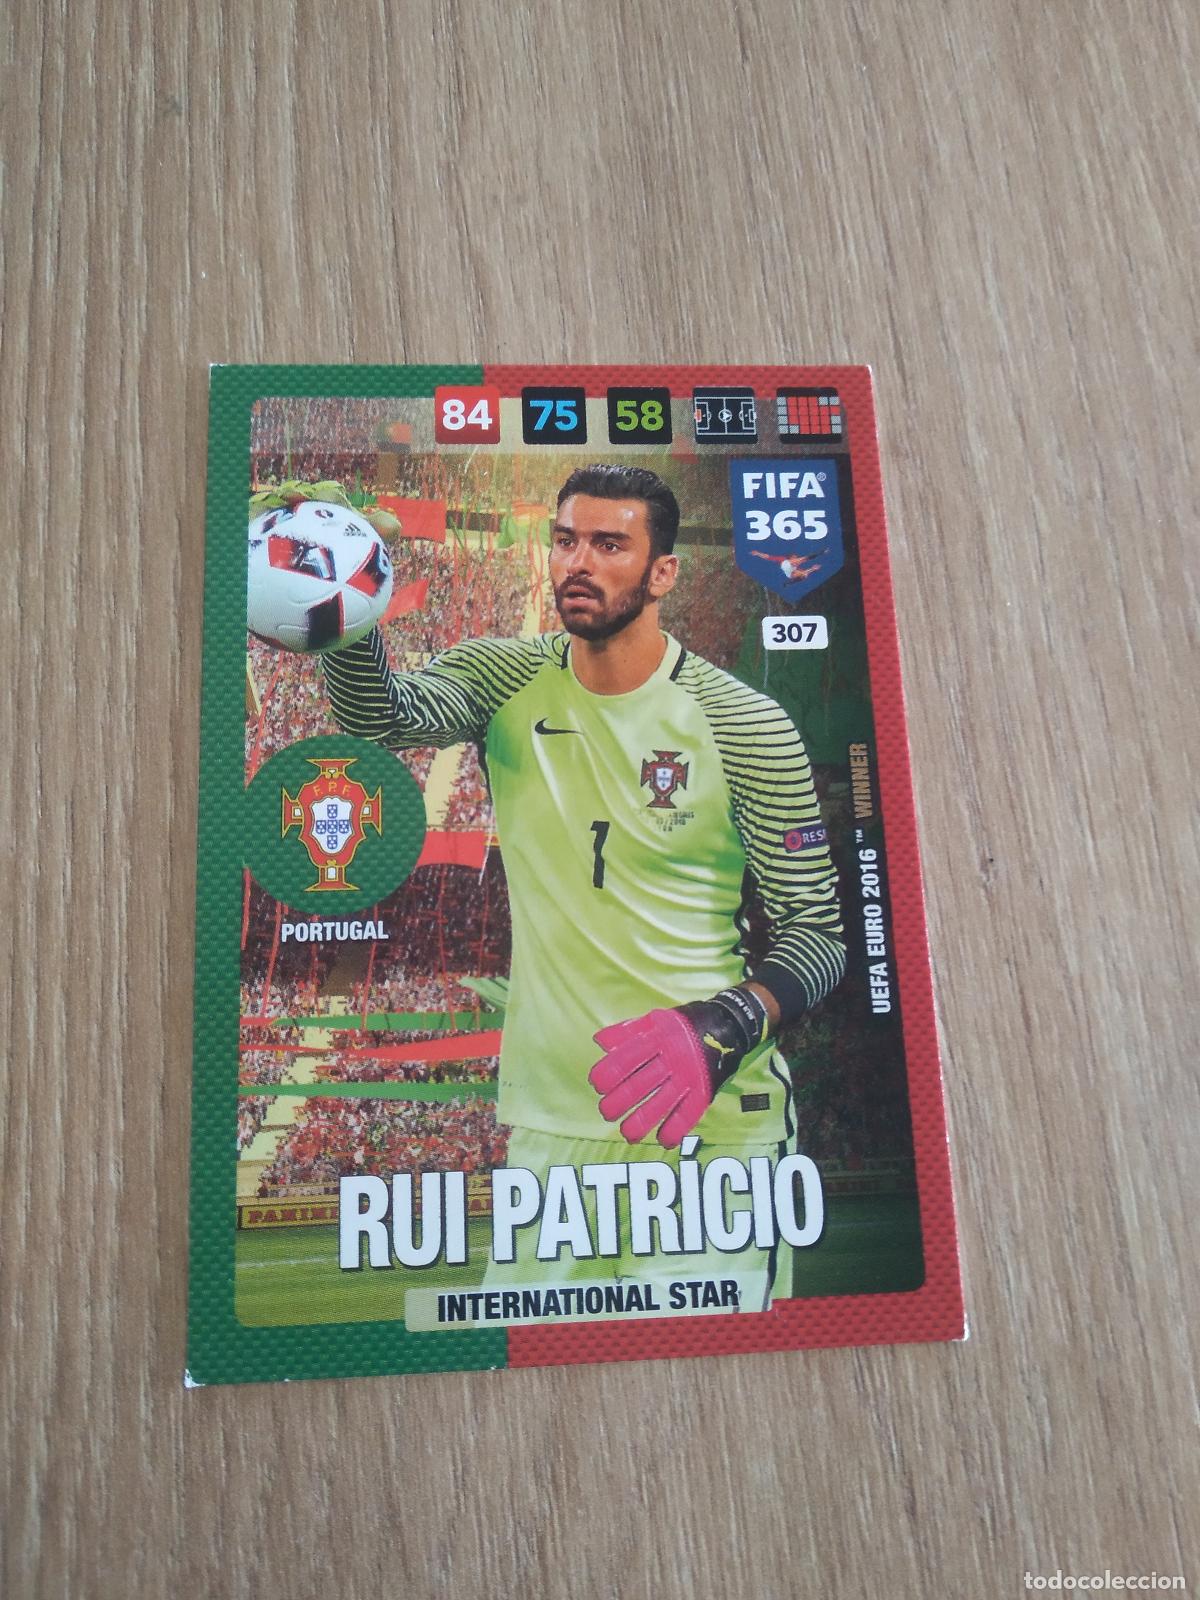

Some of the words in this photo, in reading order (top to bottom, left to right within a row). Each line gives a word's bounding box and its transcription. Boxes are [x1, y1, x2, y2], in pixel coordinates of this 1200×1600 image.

[442, 399, 493, 431] 84
[529, 400, 578, 431] 75
[615, 400, 664, 431] 58
[745, 509, 829, 541] 365
[771, 622, 818, 643] 307
[848, 743, 873, 819] WINNER
[590, 820, 611, 889] 1
[858, 848, 881, 898] 2016
[280, 920, 390, 943] PORTUGAL
[863, 903, 886, 957] EURO
[868, 962, 892, 1014] UEFA
[339, 1170, 466, 1270] RUI
[491, 1135, 826, 1263] PATRÍCIO
[436, 1284, 661, 1323] INTERNATIONAL
[668, 1279, 739, 1310] STAR
